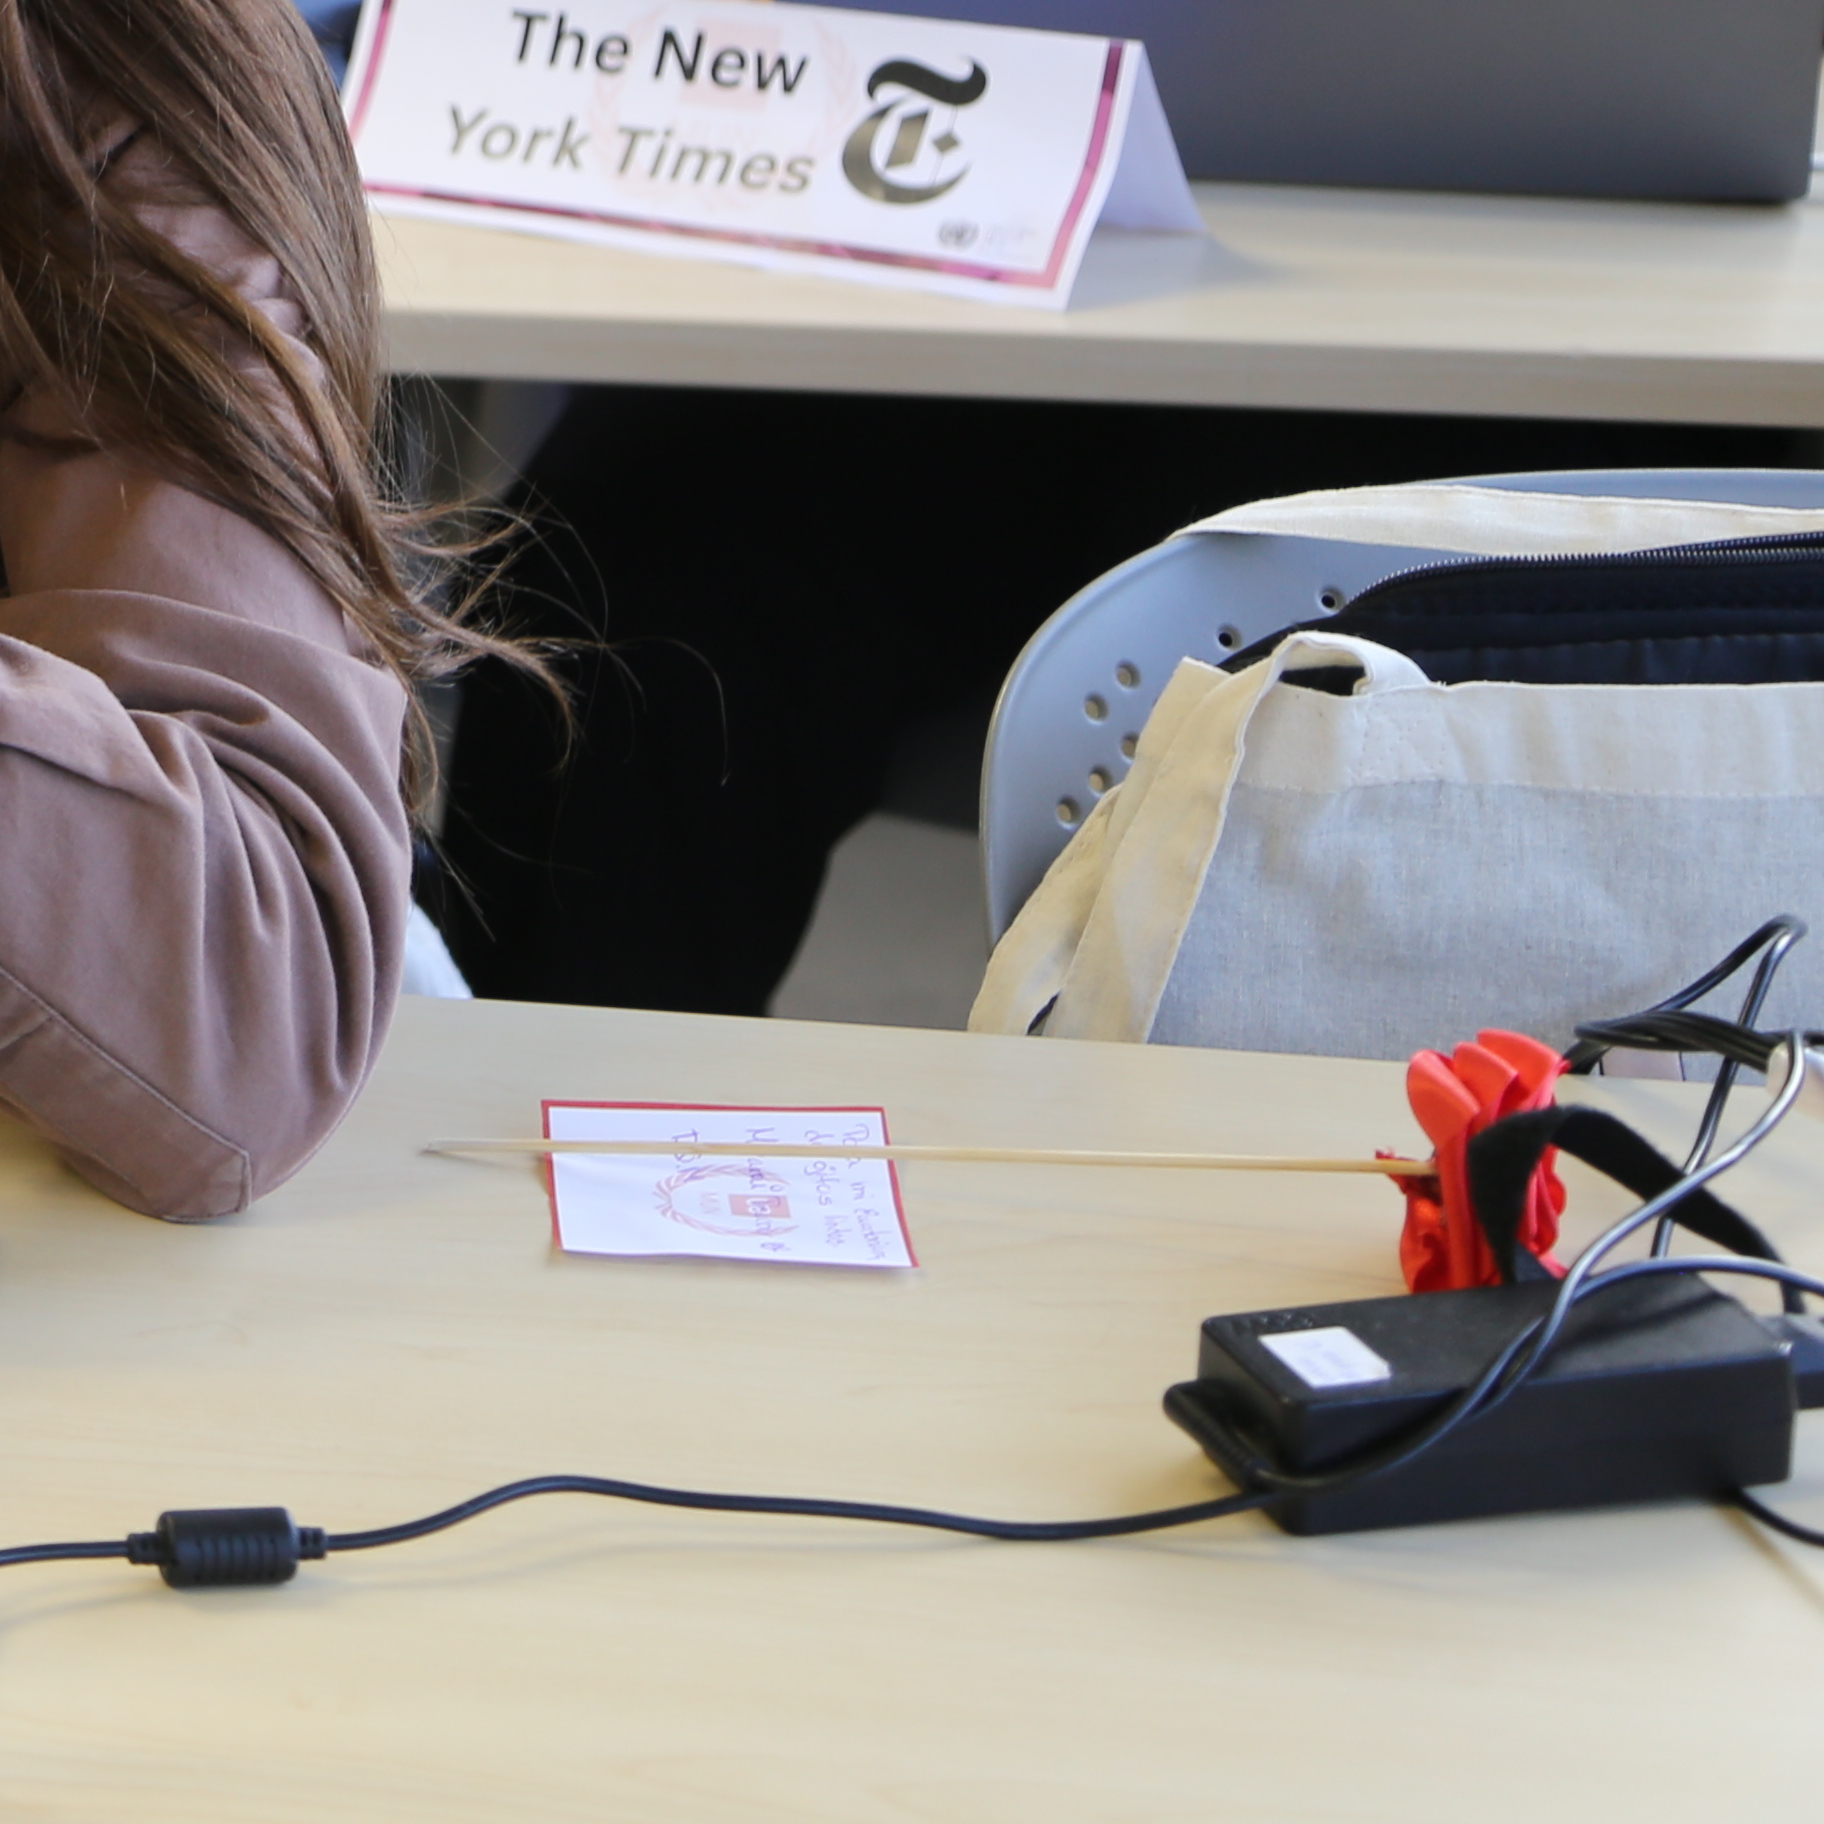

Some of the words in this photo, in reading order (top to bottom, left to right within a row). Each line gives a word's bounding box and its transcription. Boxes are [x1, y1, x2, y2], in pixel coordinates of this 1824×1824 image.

[511, 8, 630, 75] The
[653, 26, 810, 96] New
[450, 102, 591, 171] York
[617, 124, 817, 194] Times
